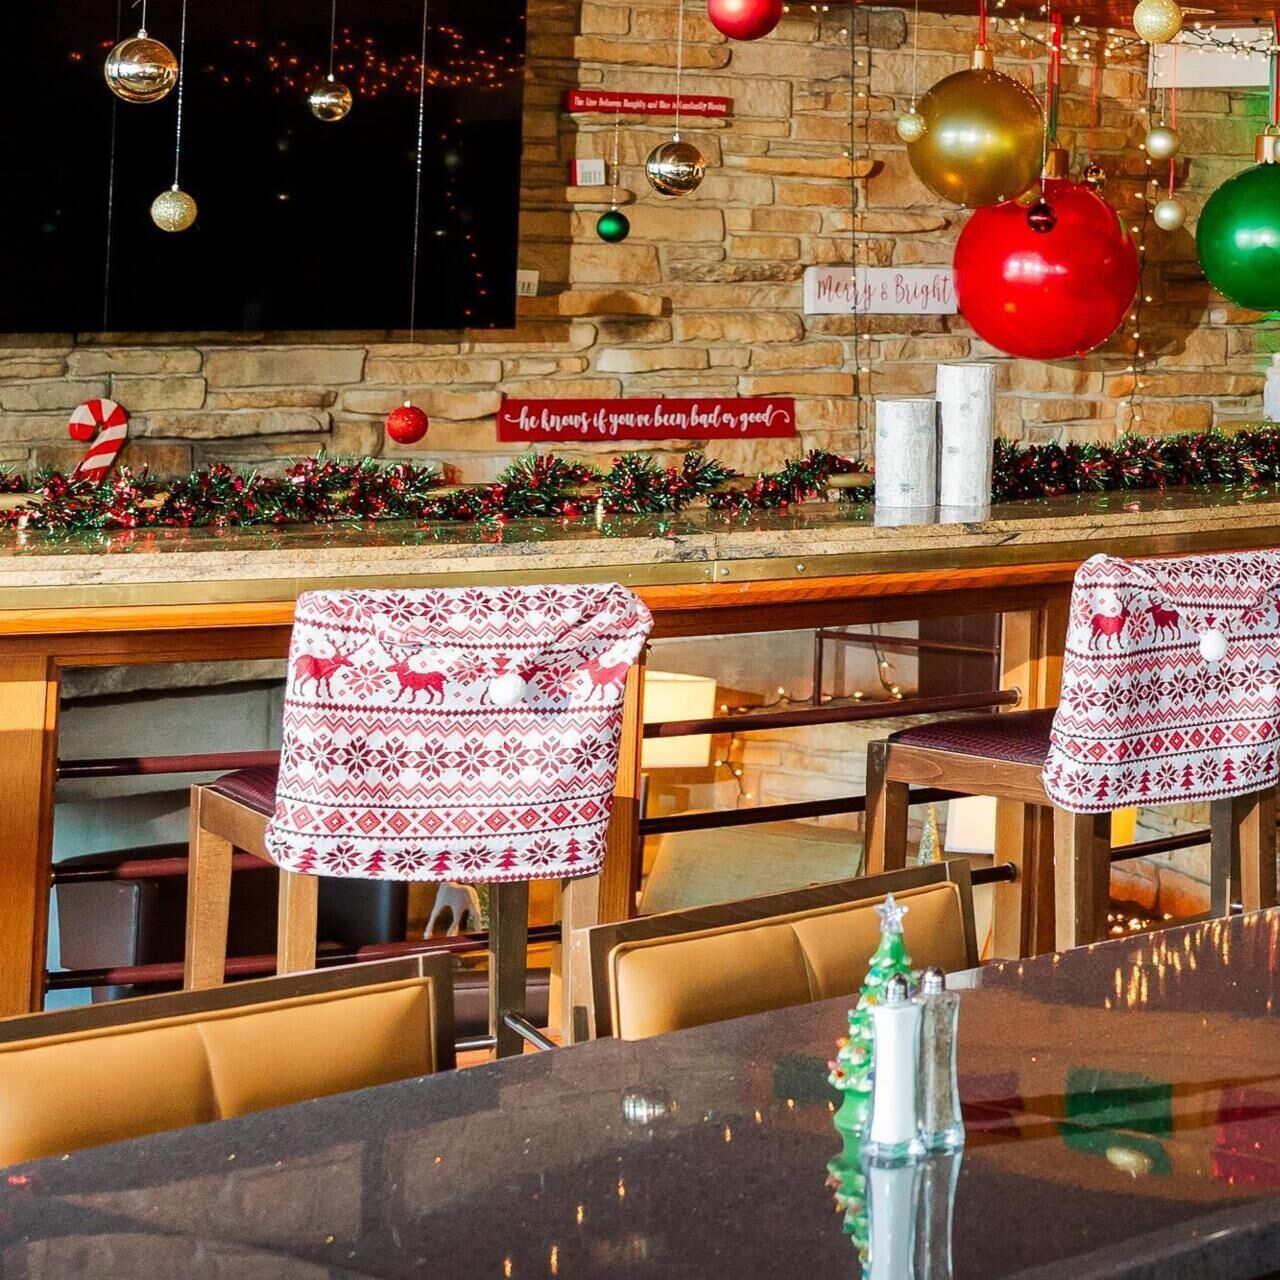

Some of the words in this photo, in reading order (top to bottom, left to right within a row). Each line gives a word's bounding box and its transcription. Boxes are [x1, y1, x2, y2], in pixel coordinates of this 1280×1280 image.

[585, 96, 598, 107] Line
[598, 97, 622, 108] Between
[623, 98, 646, 110] Naughty
[817, 275, 874, 311] Merry
[894, 273, 952, 310] Bright
[507, 405, 540, 431] he
[541, 408, 590, 434] knows
[592, 408, 608, 434] if
[654, 404, 690, 429] been
[690, 404, 721, 428] bad
[722, 412, 739, 429] or
[740, 404, 790, 432] good
